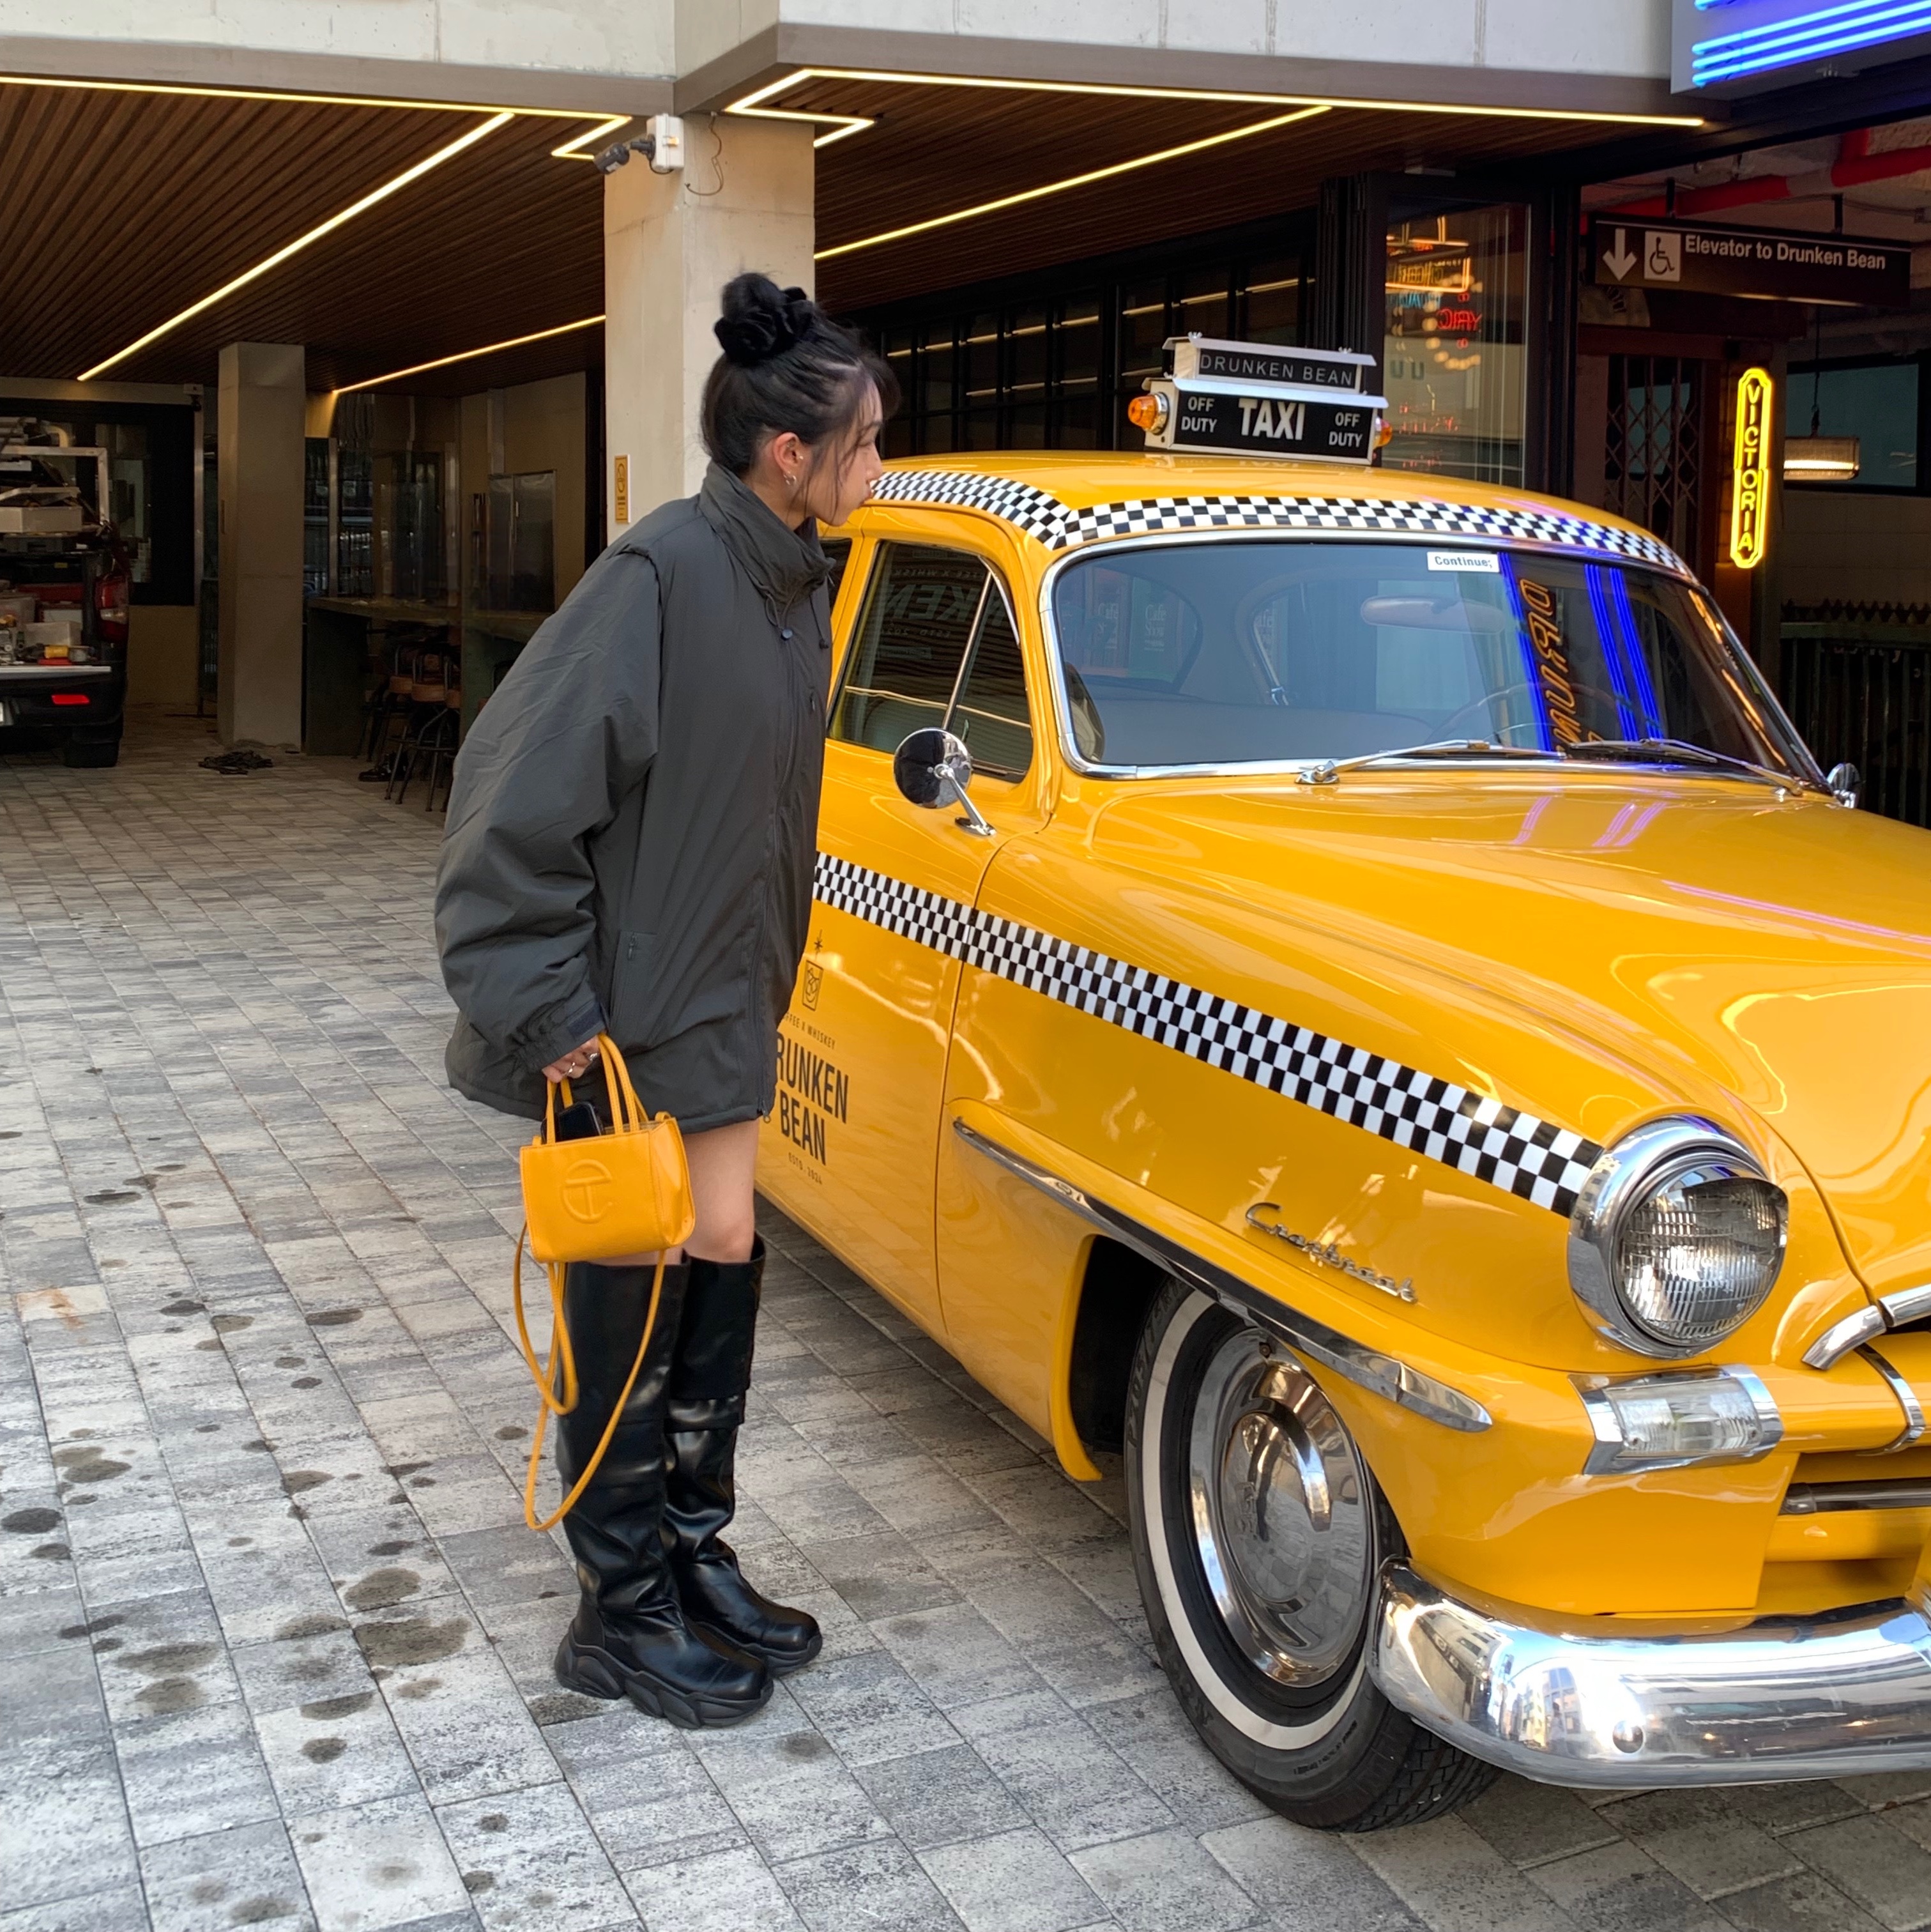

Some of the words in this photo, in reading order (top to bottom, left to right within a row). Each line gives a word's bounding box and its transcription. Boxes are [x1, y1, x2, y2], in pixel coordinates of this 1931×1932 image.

[1685, 234, 1751, 259] Elevator
[1757, 243, 1772, 261] to
[1776, 243, 1842, 267] Drunken
[1847, 249, 1886, 270] Bean
[1200, 354, 1294, 379] DRUNKEN
[1302, 366, 1352, 386] BEAN
[1181, 416, 1217, 433] DUTY
[1329, 430, 1363, 448] DUTY
[1187, 396, 1214, 412] OFF
[1238, 397, 1306, 441] TAXI
[1335, 411, 1361, 427] OFF
[1736, 383, 1760, 552] VICTORIA
[807, 1025, 836, 1050] WHISKEY
[777, 1030, 849, 1124] RUNKEN
[779, 1088, 827, 1167] BEAN
[1245, 1201, 1419, 1305] Cranbrook
